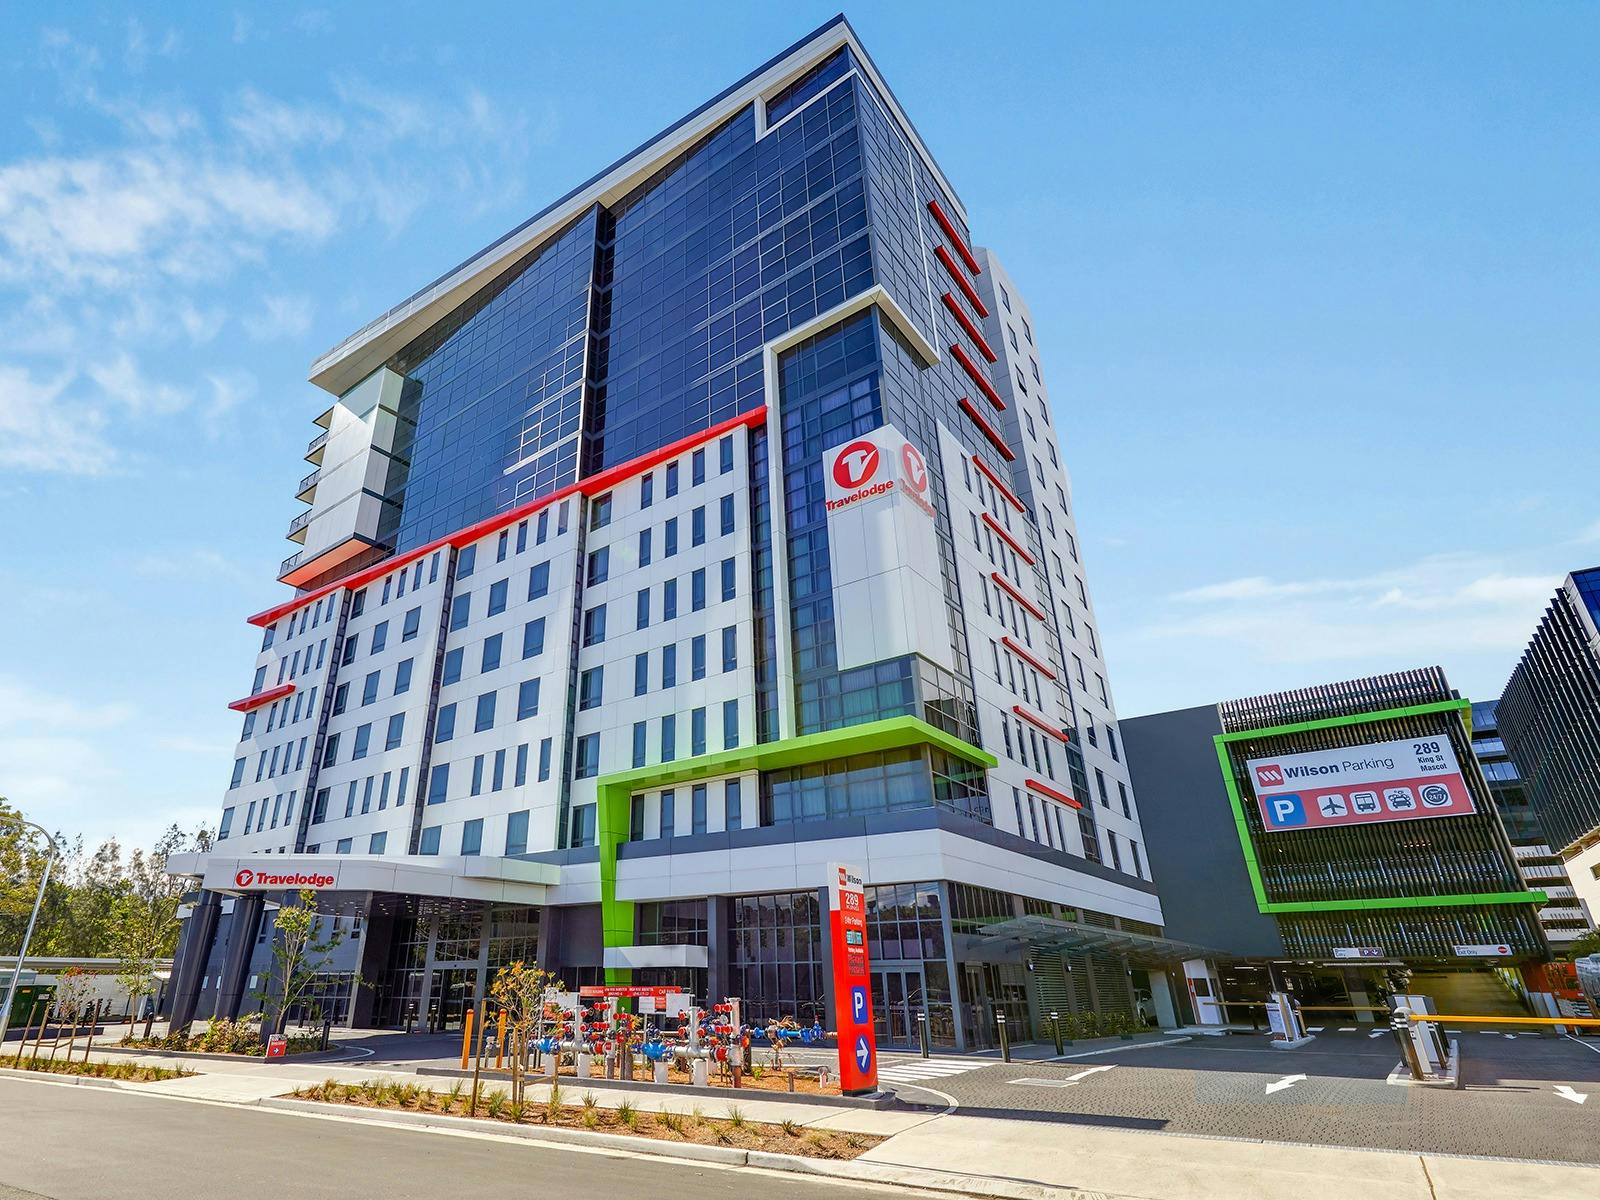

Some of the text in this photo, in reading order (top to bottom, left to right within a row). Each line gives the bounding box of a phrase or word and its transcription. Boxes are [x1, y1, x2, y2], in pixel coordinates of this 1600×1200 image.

[825, 480, 894, 511] Travelodge
[1413, 741, 1440, 755] 289
[1417, 754, 1444, 764] King St
[1284, 758, 1394, 779] Wilson Parking
[1420, 763, 1448, 772] Mascot
[1273, 800, 1295, 822] P
[256, 872, 335, 887] Travelodge
[845, 892, 859, 906] 289
[854, 992, 863, 1018] P
